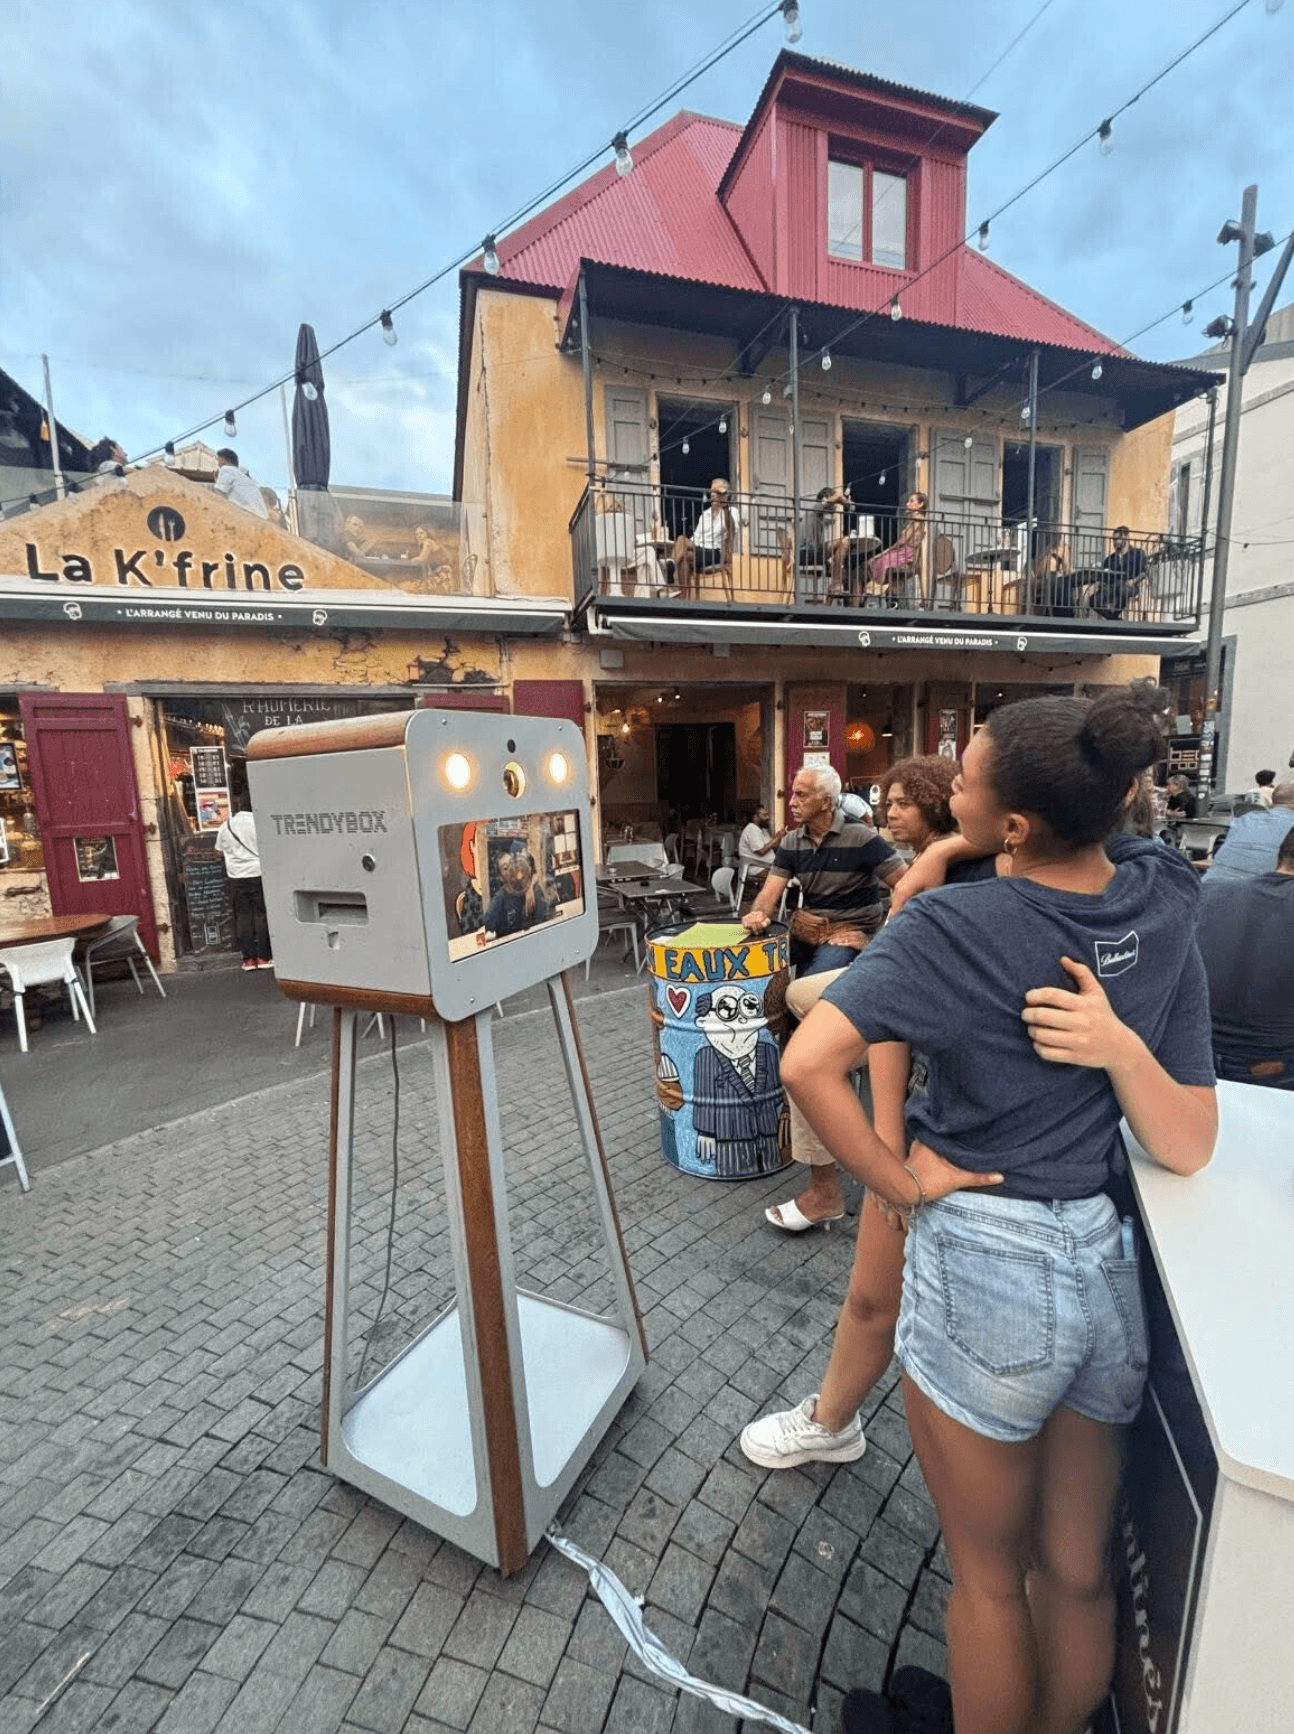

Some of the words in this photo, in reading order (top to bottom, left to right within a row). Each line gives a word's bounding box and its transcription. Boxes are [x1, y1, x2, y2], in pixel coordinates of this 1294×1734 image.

[26, 543, 93, 582] La
[114, 548, 304, 592] K'frine
[125, 607, 182, 619] L'ARRANGÉ
[184, 610, 212, 619] VENU
[215, 611, 229, 620] DU
[232, 611, 274, 621] PARADIS
[935, 636, 953, 645] VENU
[954, 637, 964, 645] DU
[965, 637, 993, 646] PARADIS
[243, 698, 331, 714] RHUMERIE
[265, 715, 281, 726] DE
[287, 714, 304, 726] LA
[270, 810, 388, 836] TRENDYBOX
[665, 947, 750, 981] EAUX
